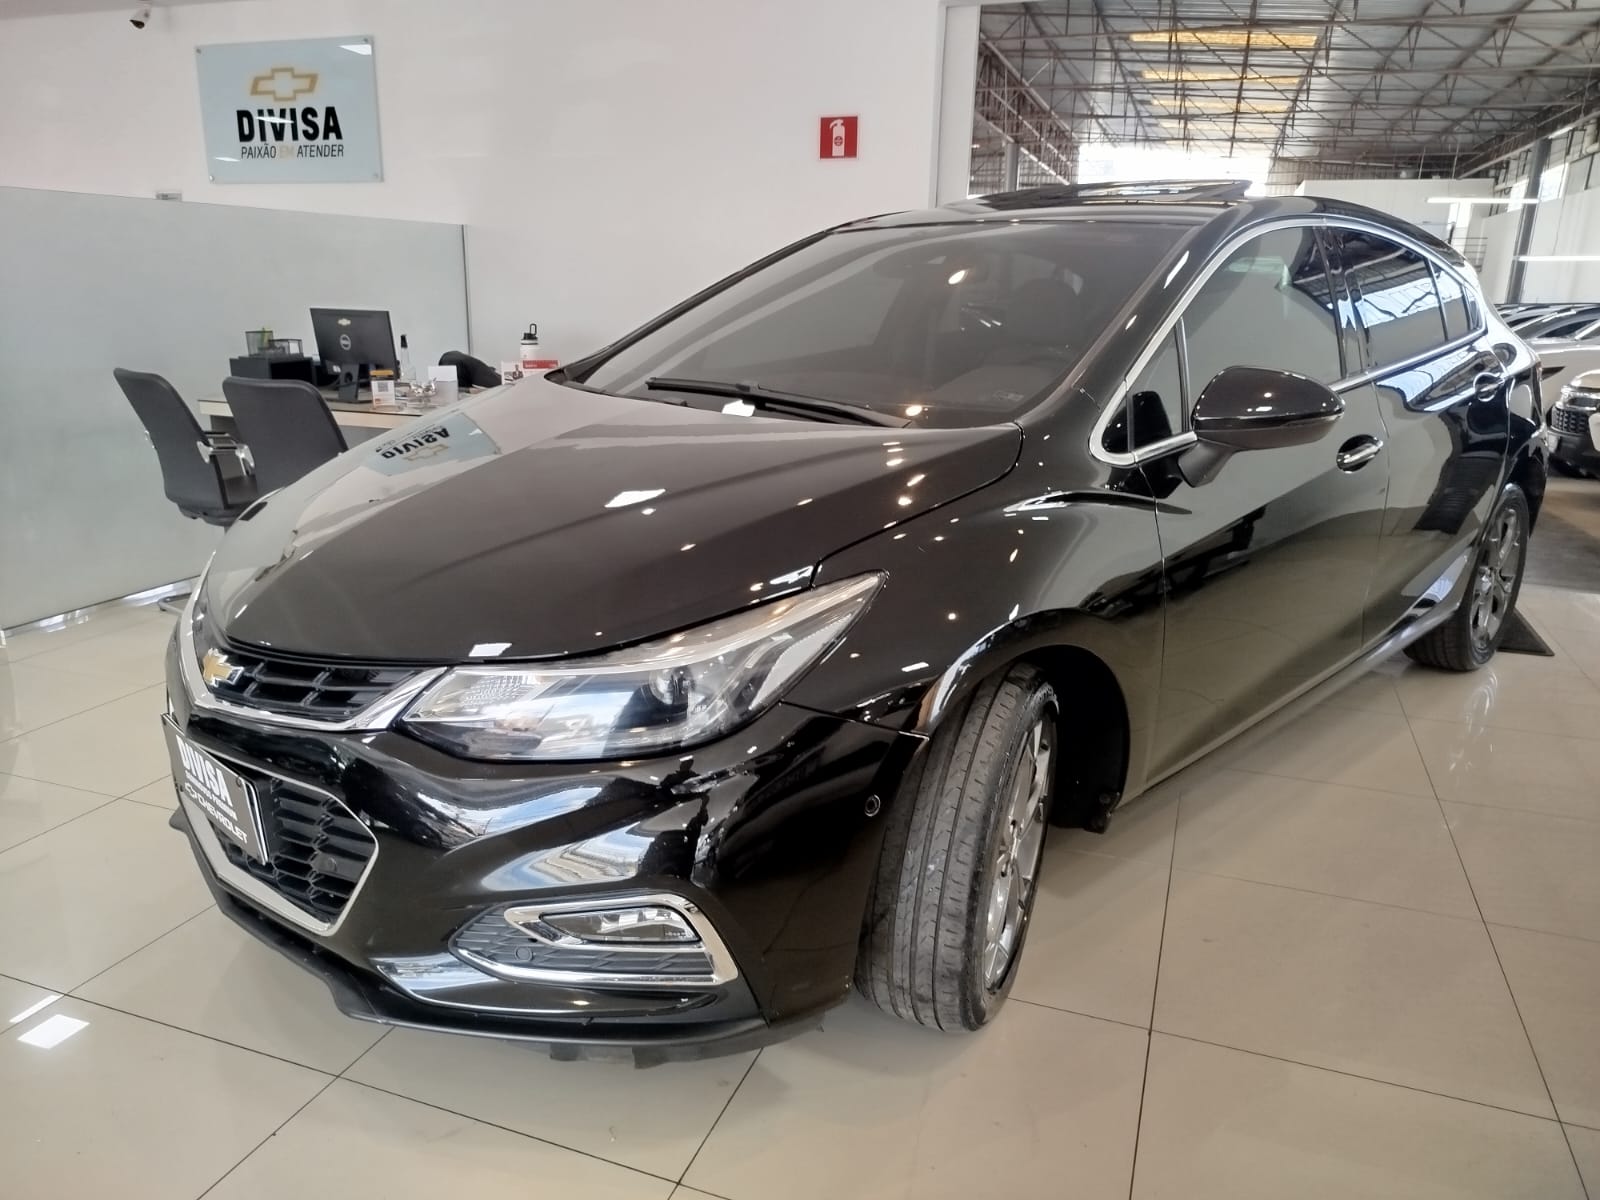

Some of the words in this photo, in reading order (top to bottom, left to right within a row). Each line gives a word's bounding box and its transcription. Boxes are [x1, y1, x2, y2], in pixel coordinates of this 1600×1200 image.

[236, 106, 343, 142] DIVISA
[241, 143, 277, 159] PAIXÃO
[296, 144, 344, 158] ATENDER
[176, 734, 233, 807] DIVISA
[197, 792, 248, 844] CHEVROLET
